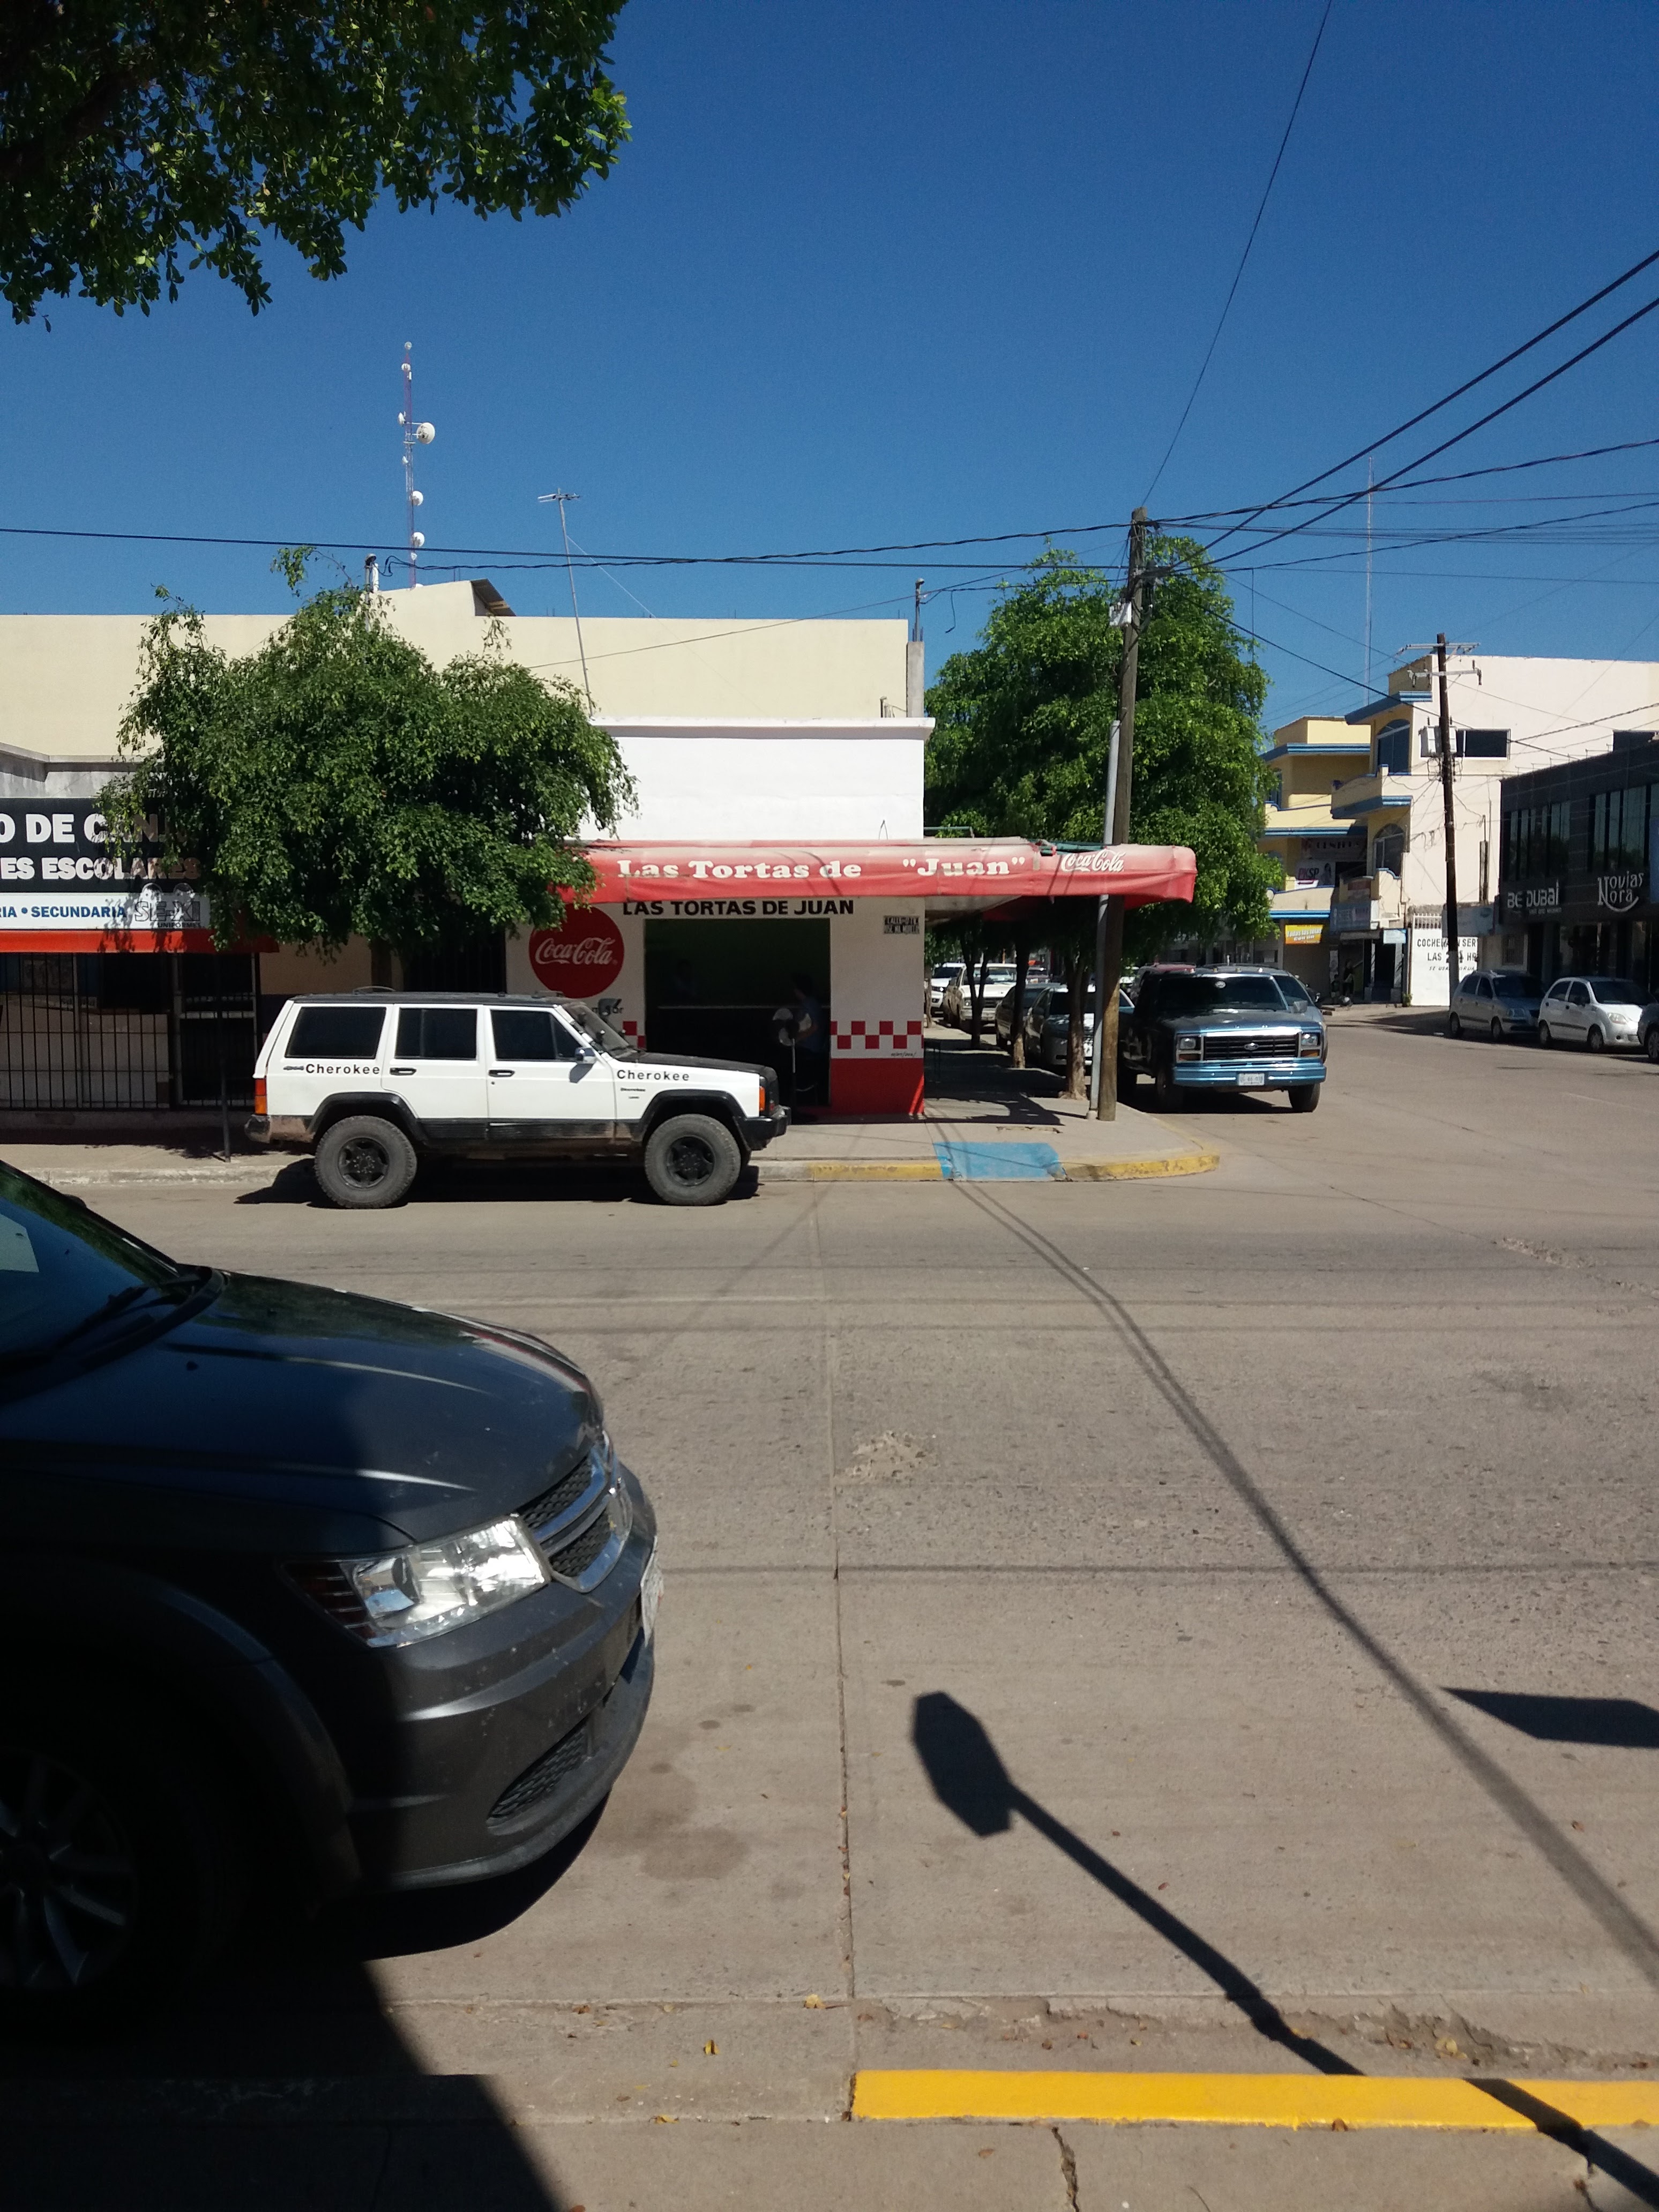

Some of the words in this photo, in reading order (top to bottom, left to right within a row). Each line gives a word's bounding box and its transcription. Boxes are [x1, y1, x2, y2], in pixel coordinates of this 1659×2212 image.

[26, 813, 75, 843] DE
[41, 857, 201, 880] ESCOLARES
[617, 860, 679, 878] Las
[689, 860, 809, 879] Tortas
[820, 861, 862, 878] de
[902, 856, 1025, 876] "Juan"
[1061, 849, 1125, 873] Coca-Cola
[0, 906, 17, 917] IA
[31, 906, 126, 918] SECUNDARIA
[623, 901, 663, 915] LAS
[671, 900, 757, 915] TORTAS
[762, 900, 788, 915] DE
[794, 900, 854, 914] JUAN
[535, 938, 616, 965] Coca-Cola
[1428, 953, 1442, 961] LAS
[305, 1064, 380, 1074] Cherokee
[617, 1070, 690, 1081] Cherokee
